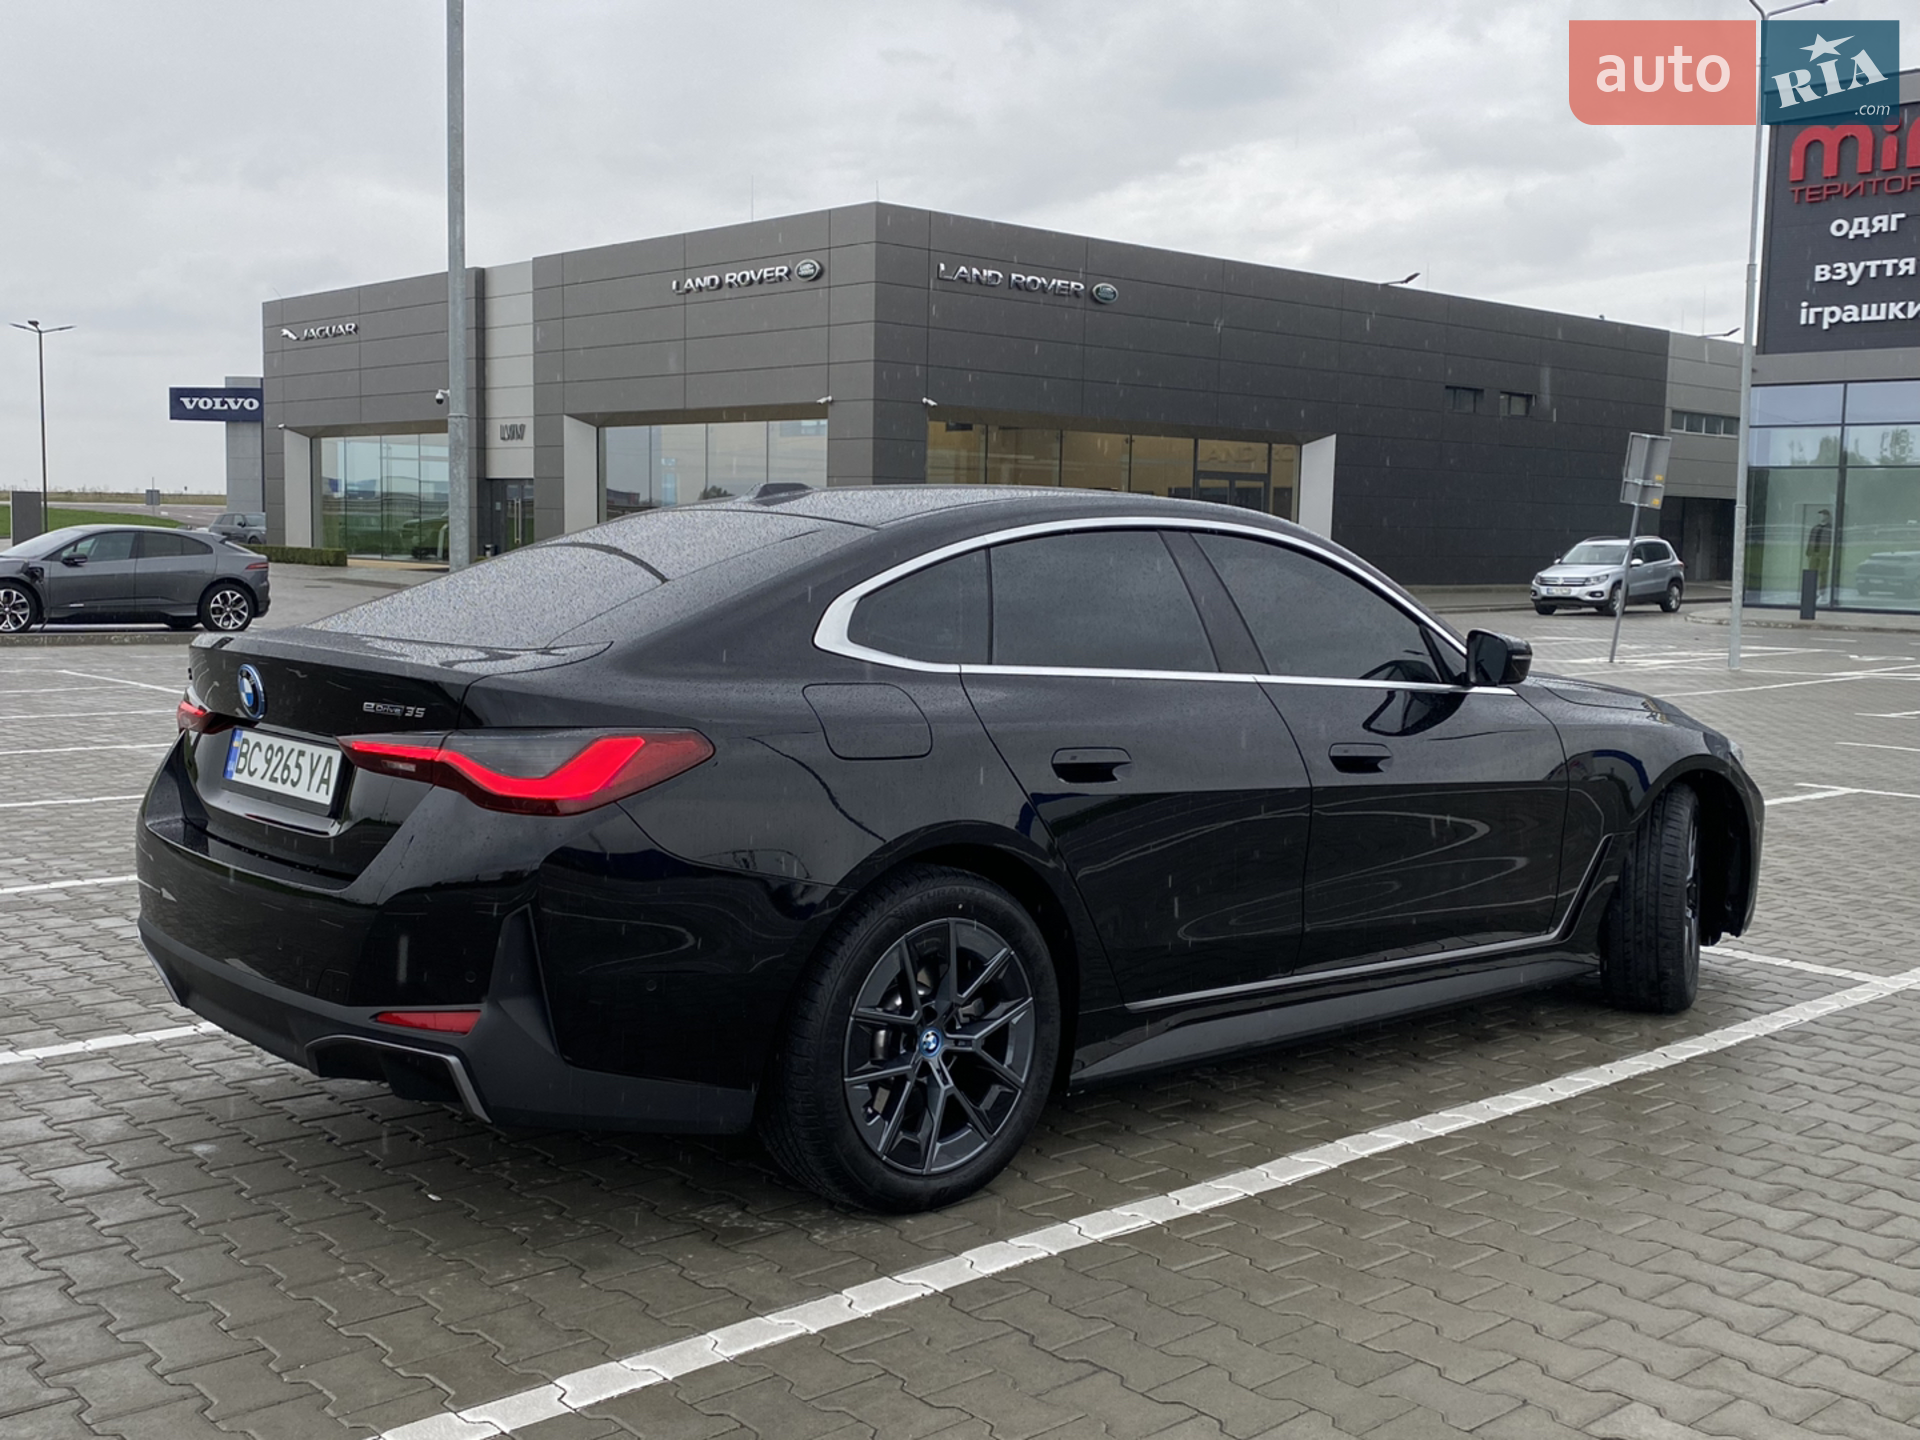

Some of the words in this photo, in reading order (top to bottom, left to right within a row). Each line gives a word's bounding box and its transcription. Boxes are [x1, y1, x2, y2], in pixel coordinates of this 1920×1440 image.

[1830, 212, 1906, 239] одяг
[671, 274, 721, 294] LAND
[724, 265, 791, 288] ROVER
[937, 262, 1004, 287] LAND
[1009, 272, 1085, 297] ROVER
[1814, 257, 1917, 286] взуття
[1800, 301, 1920, 330] іграшки
[302, 322, 358, 340] JAGUAR
[179, 397, 260, 411] VOLVO
[915, 887, 987, 903] TURANZA
